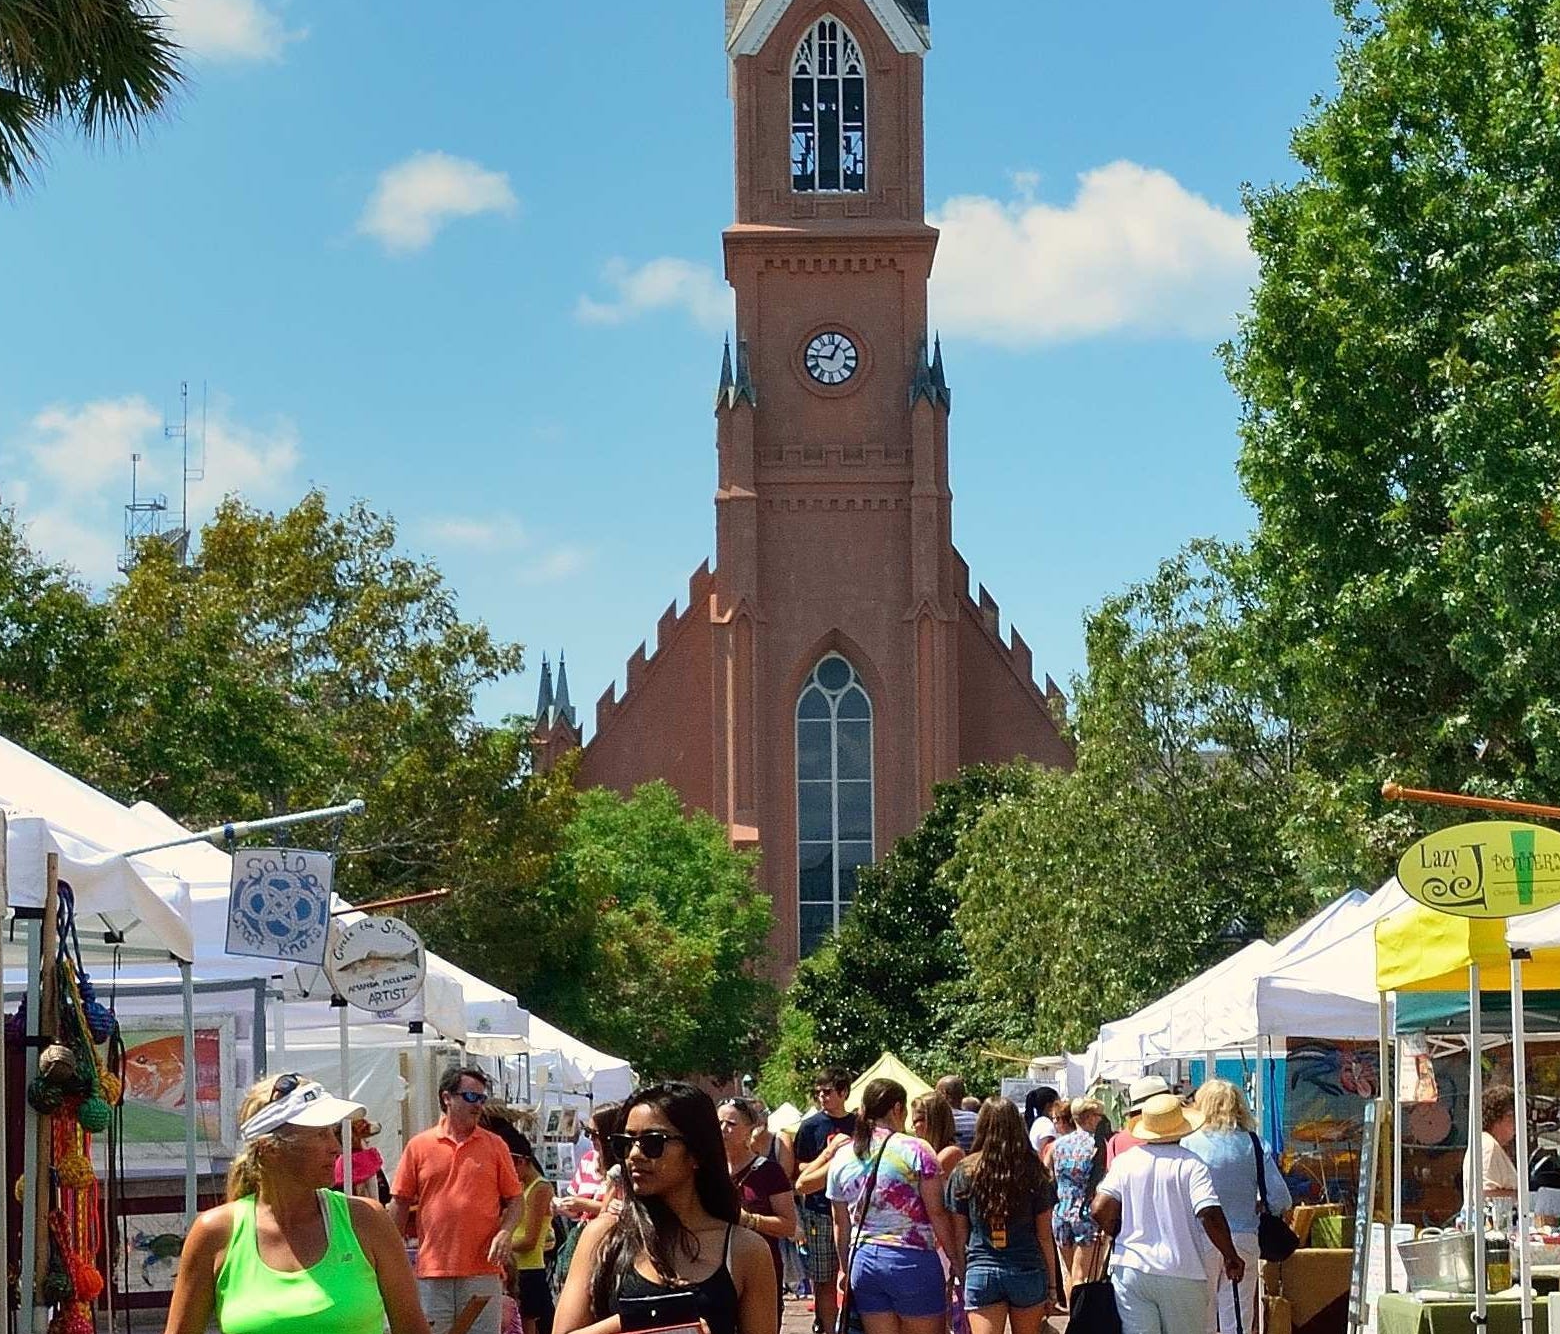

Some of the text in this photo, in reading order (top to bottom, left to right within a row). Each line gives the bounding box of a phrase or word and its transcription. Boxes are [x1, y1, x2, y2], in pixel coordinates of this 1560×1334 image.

[246, 855, 327, 895] Sailor
[1419, 842, 1487, 910] Lazy J
[368, 987, 409, 1006] ARTIST
